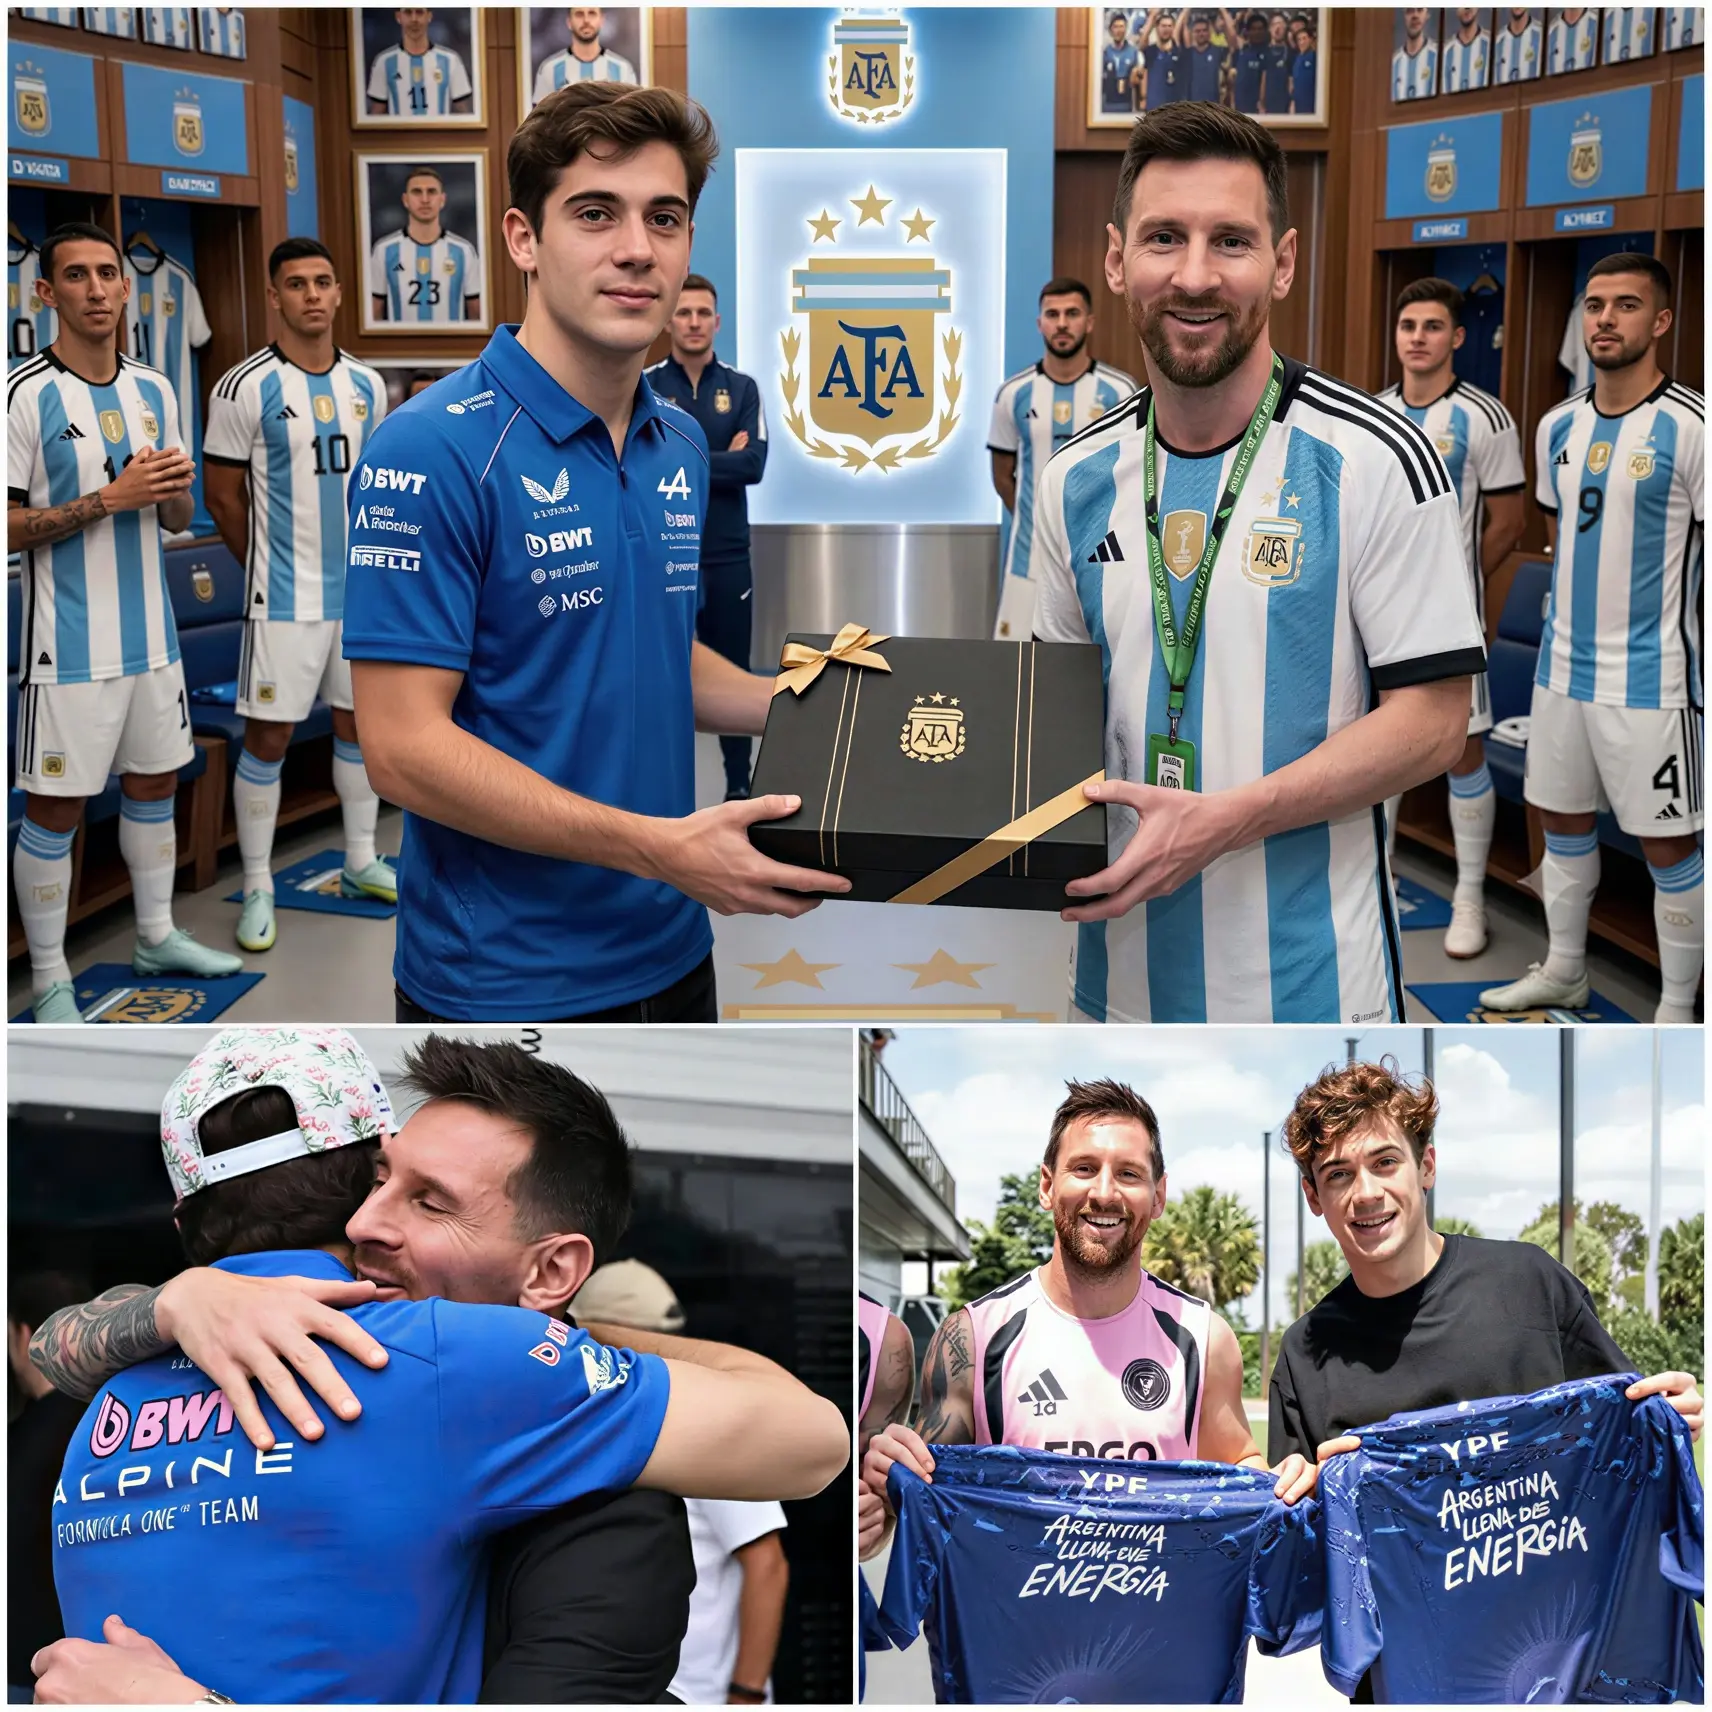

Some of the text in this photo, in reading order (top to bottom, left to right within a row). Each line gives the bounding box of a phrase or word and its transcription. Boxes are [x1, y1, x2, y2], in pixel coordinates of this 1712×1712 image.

[844, 50, 897, 99] AFA
[408, 280, 441, 306] 23
[817, 319, 925, 419] AFA
[311, 433, 351, 475] 10
[1578, 486, 1603, 533] 9
[548, 527, 593, 553] BWT
[561, 587, 603, 612] MSC
[1652, 754, 1682, 799] 4
[52, 1442, 294, 1508] ALPINE
[1078, 1469, 1149, 1495] YPF
[141, 1506, 178, 1534] ONE
[200, 1495, 259, 1526] TEAM
